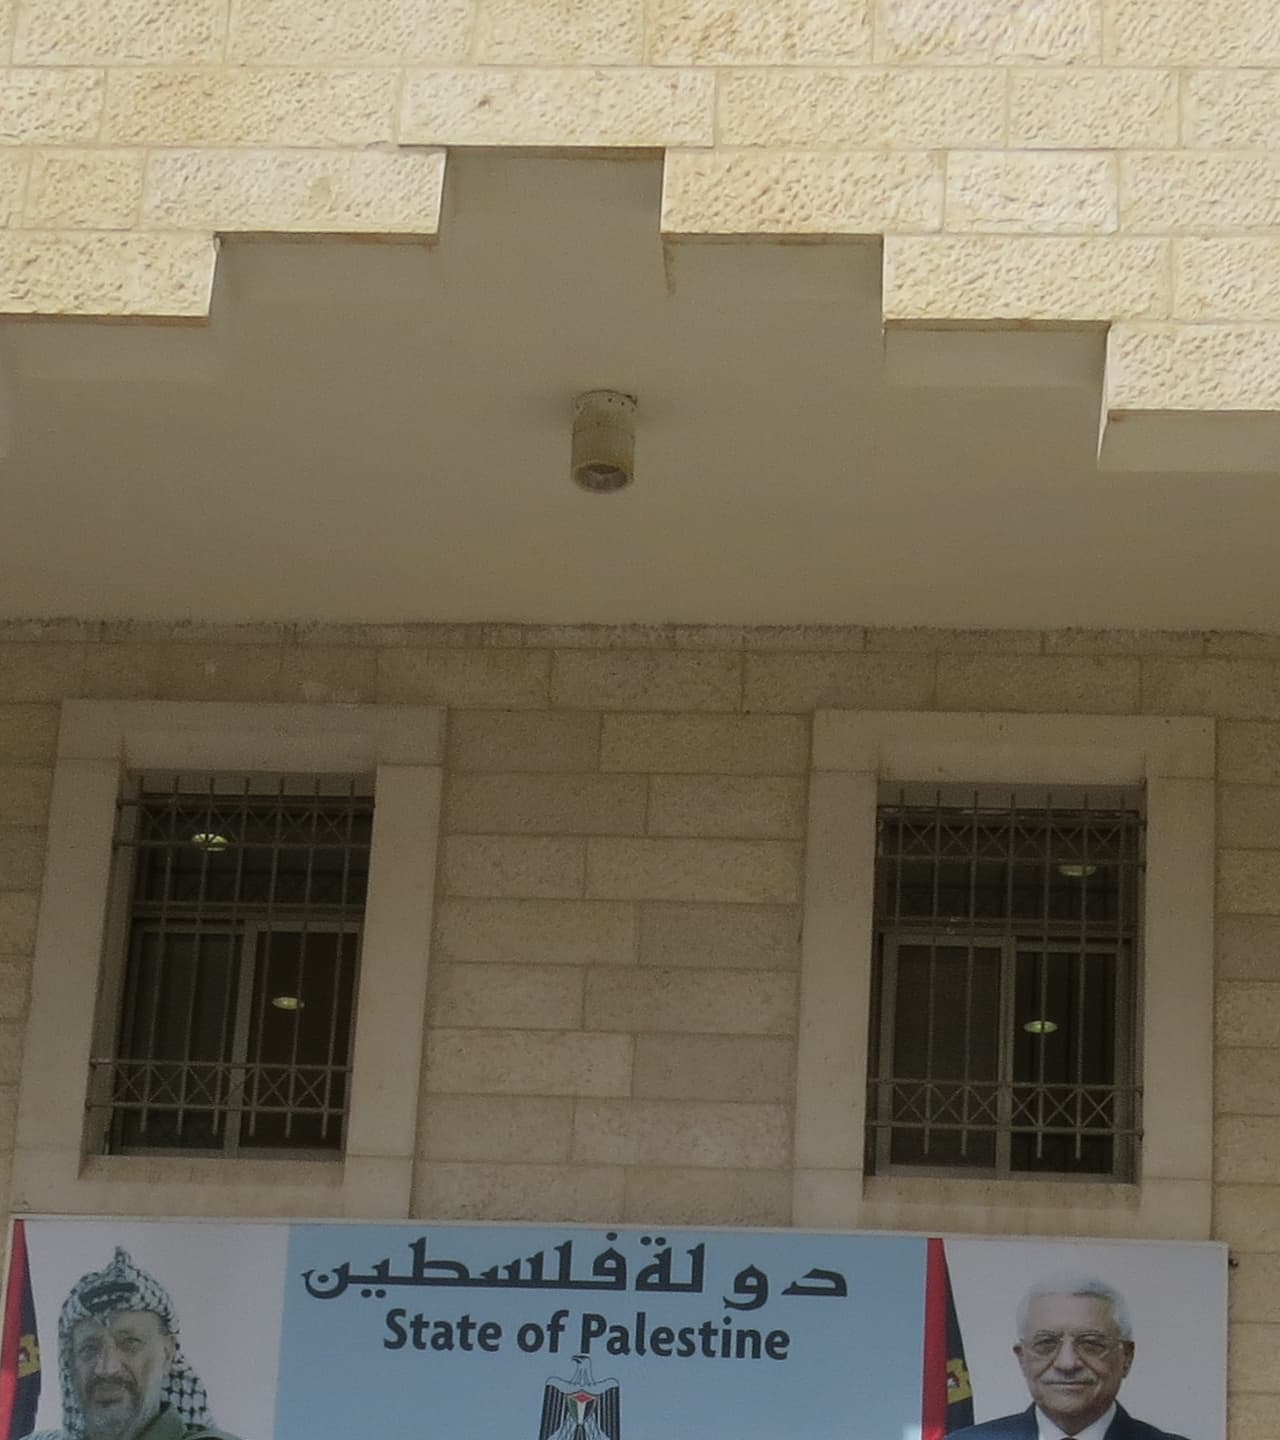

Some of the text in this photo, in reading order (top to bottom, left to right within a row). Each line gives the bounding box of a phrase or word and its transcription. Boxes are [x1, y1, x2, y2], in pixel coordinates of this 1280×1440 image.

[300, 1230, 849, 1313] دولة فلسطين
[383, 1306, 791, 1362] State of Palestine
